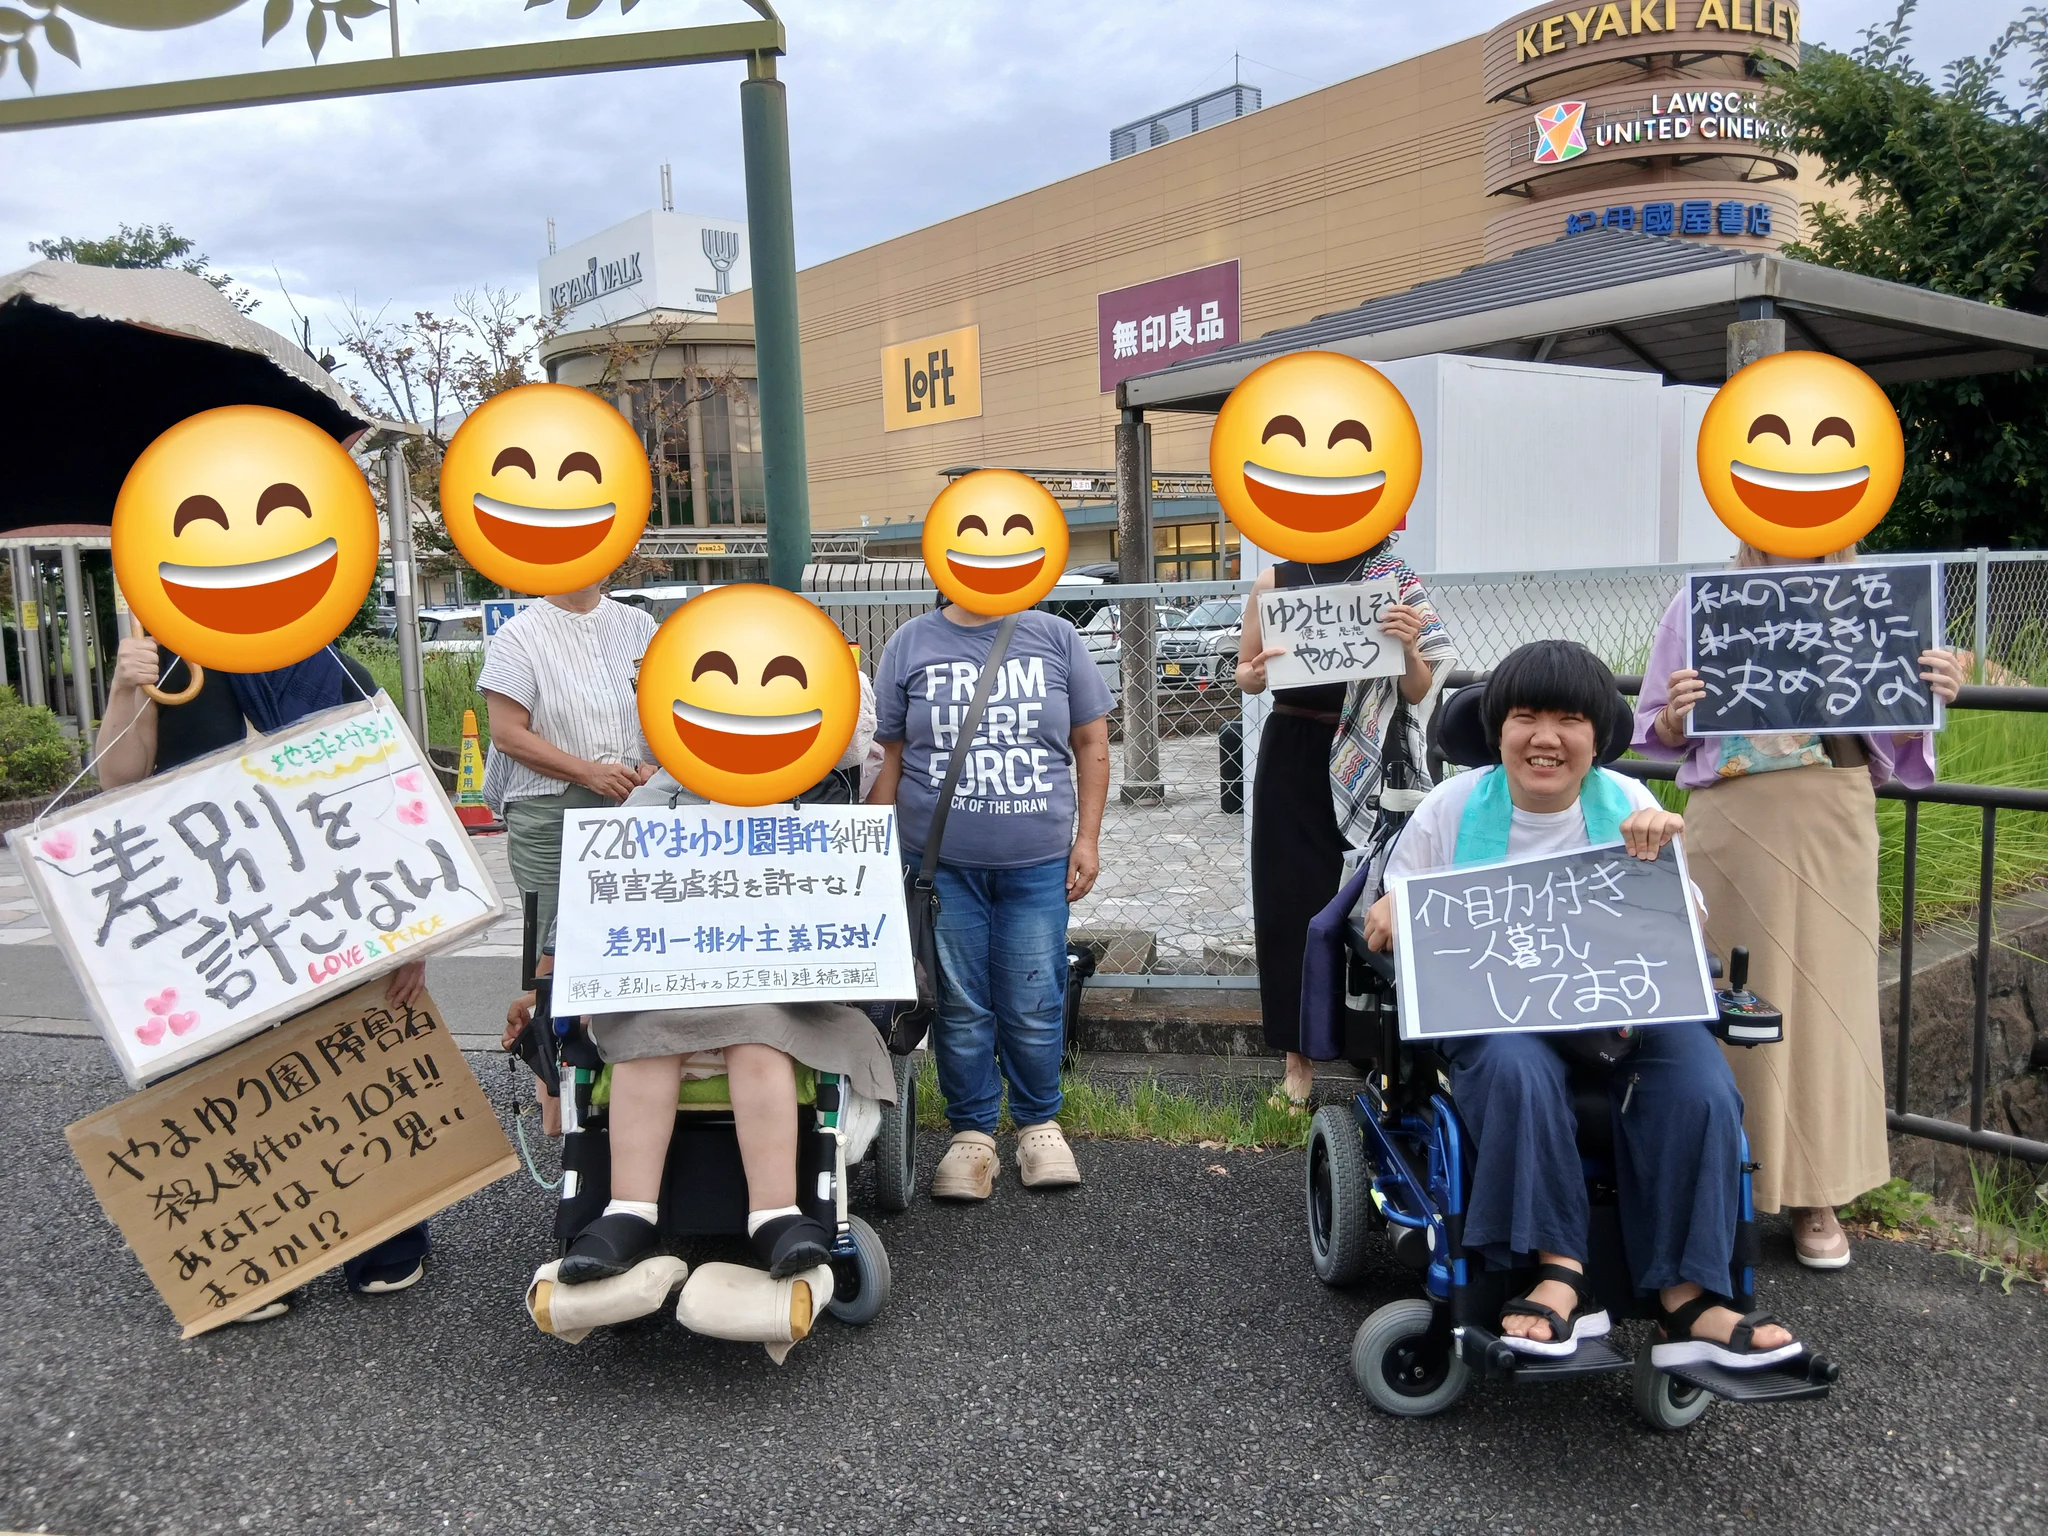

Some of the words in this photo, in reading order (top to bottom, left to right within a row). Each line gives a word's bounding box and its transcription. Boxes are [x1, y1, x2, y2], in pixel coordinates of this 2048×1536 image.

[1516, 0, 1676, 63] KEYAKI
[1696, 0, 1800, 44] ALLEY
[1596, 118, 1691, 146] UNITED
[1566, 200, 1773, 236] 紀伊國屋書店
[549, 258, 598, 311] KEYAKI
[600, 252, 642, 291] WALK
[1112, 300, 1224, 360] 無印良品
[1691, 574, 1892, 614] 私のことを
[1293, 637, 1380, 675] やめよう
[1299, 626, 1328, 640] 優生
[1338, 625, 1365, 637] 思想
[1698, 615, 1918, 656] 私抜きに
[1700, 652, 1927, 716] 決めるな
[968, 799, 985, 813] OF
[988, 800, 1011, 814] THE
[1014, 797, 1048, 813] DRAW
[90, 784, 361, 948] 差別を
[1415, 860, 1626, 930] 介助付き
[181, 838, 460, 1009] 許さない
[308, 944, 364, 984] LOVE
[364, 940, 382, 958] &
[379, 914, 446, 952] PEACE
[1433, 922, 1591, 970] 一人暮らし
[1486, 953, 1668, 1024] してます
[200, 1209, 349, 1308] ますか!?
